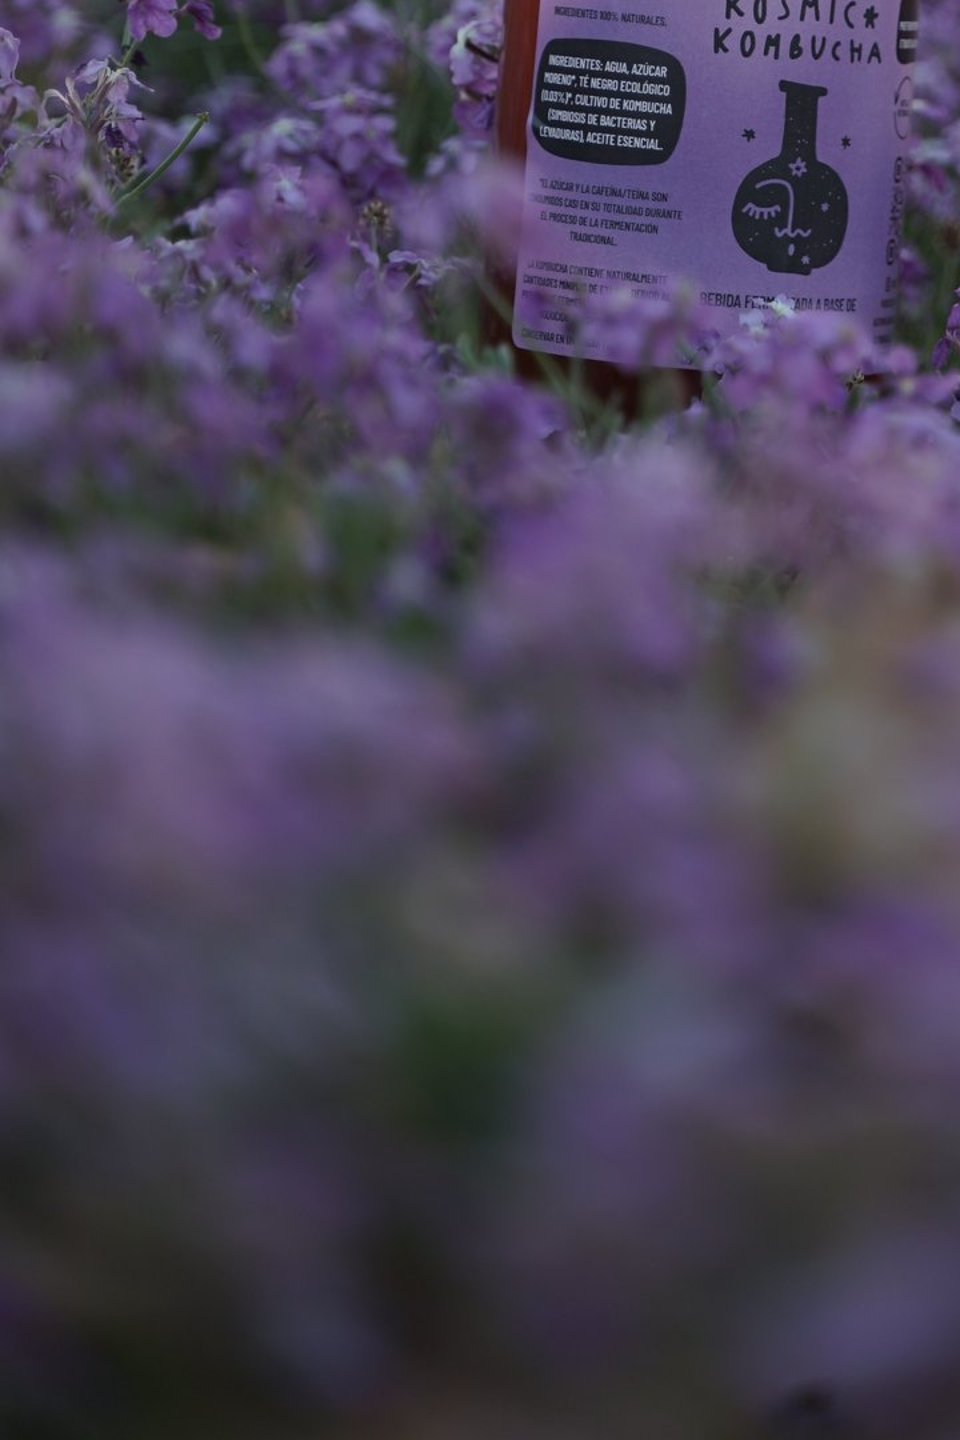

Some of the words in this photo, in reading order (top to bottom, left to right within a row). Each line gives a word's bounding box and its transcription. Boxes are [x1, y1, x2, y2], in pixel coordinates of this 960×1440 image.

[714, 27, 881, 64] KOMBUCHA
[548, 54, 603, 70] INGREDIENTES:
[631, 62, 668, 78] AZÚCAR
[579, 73, 589, 87] TÉ
[590, 77, 618, 91] NEGRO
[620, 79, 670, 96] ECOLÓGICO
[575, 93, 607, 108] CULTIVO
[609, 97, 621, 109] DE
[623, 99, 672, 115] KOMBUCHA
[588, 113, 598, 126] DE
[600, 114, 647, 130] BACTERIAS
[650, 120, 656, 131] Y
[586, 131, 616, 146] ACEITE
[581, 184, 590, 194] LA
[651, 191, 668, 202] SON
[580, 199, 590, 210] EN
[591, 200, 601, 212] SU
[603, 202, 644, 216] TOTALIDAD
[644, 207, 682, 220] DURANTE
[578, 215, 587, 226] DE
[589, 218, 599, 229] LA
[700, 292, 740, 308] BEBIDA
[823, 298, 845, 311] BASE
[845, 298, 857, 311] DE
